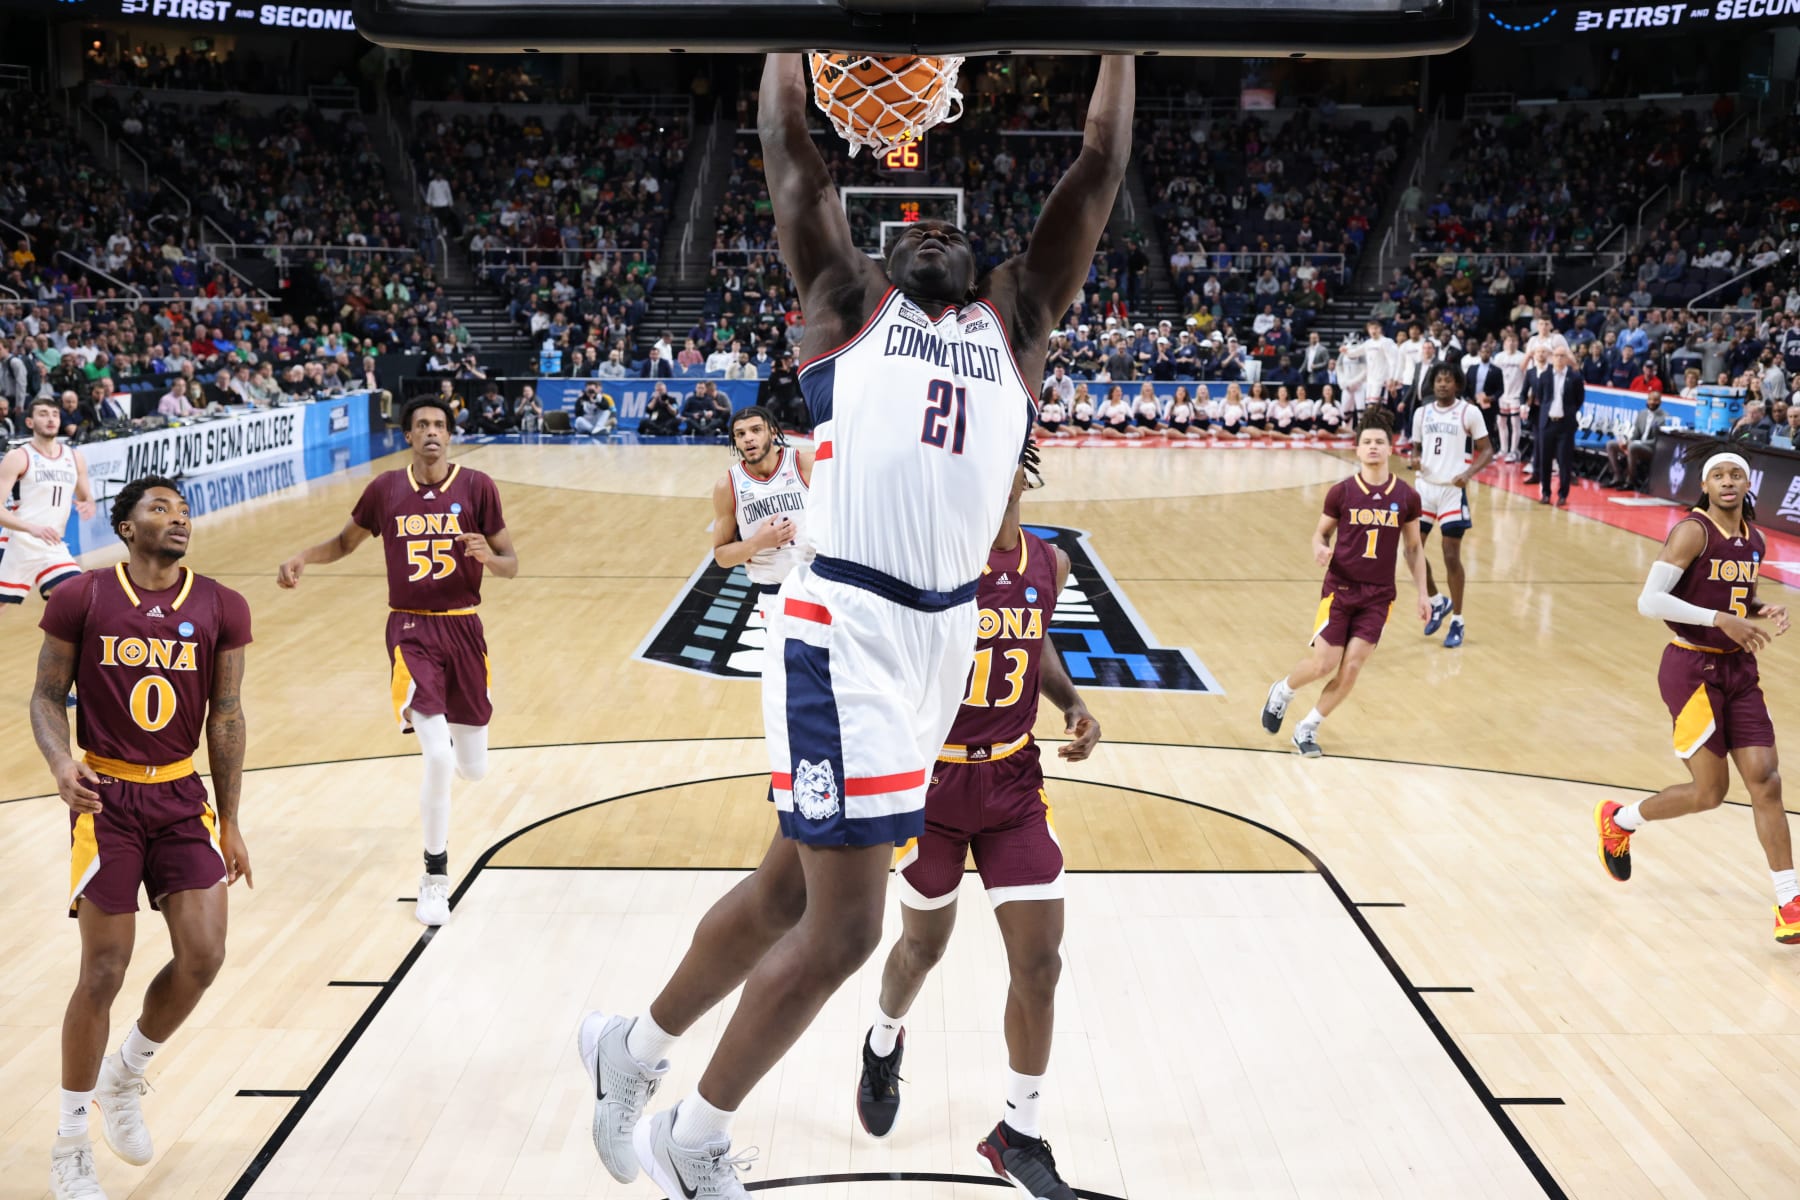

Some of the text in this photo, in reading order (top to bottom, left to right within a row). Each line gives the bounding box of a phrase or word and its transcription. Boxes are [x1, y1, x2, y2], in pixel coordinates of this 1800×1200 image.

[152, 0, 232, 21] FIRST
[235, 9, 255, 19] AND
[1606, 4, 1688, 29] FIRST
[1690, 8, 1709, 18] AND
[887, 142, 919, 168] 26
[884, 324, 1002, 386] CONNETICUT
[921, 378, 967, 455] 21
[126, 437, 170, 482] MAAC
[173, 430, 202, 471] AND
[206, 423, 243, 465] SIENA
[246, 413, 295, 455] COLLEGE
[1434, 436, 1442, 455] 2
[52, 485, 62, 507] 11
[742, 492, 804, 525] CONNECTICUT
[395, 513, 463, 537] IONA
[1348, 508, 1399, 528] IONA
[406, 538, 457, 582] 55
[1361, 528, 1379, 559] 1
[1729, 586, 1748, 619] 5
[977, 607, 1043, 640] ONA
[99, 635, 199, 671] IONA
[962, 646, 1029, 707] 13
[129, 674, 177, 732] 0
